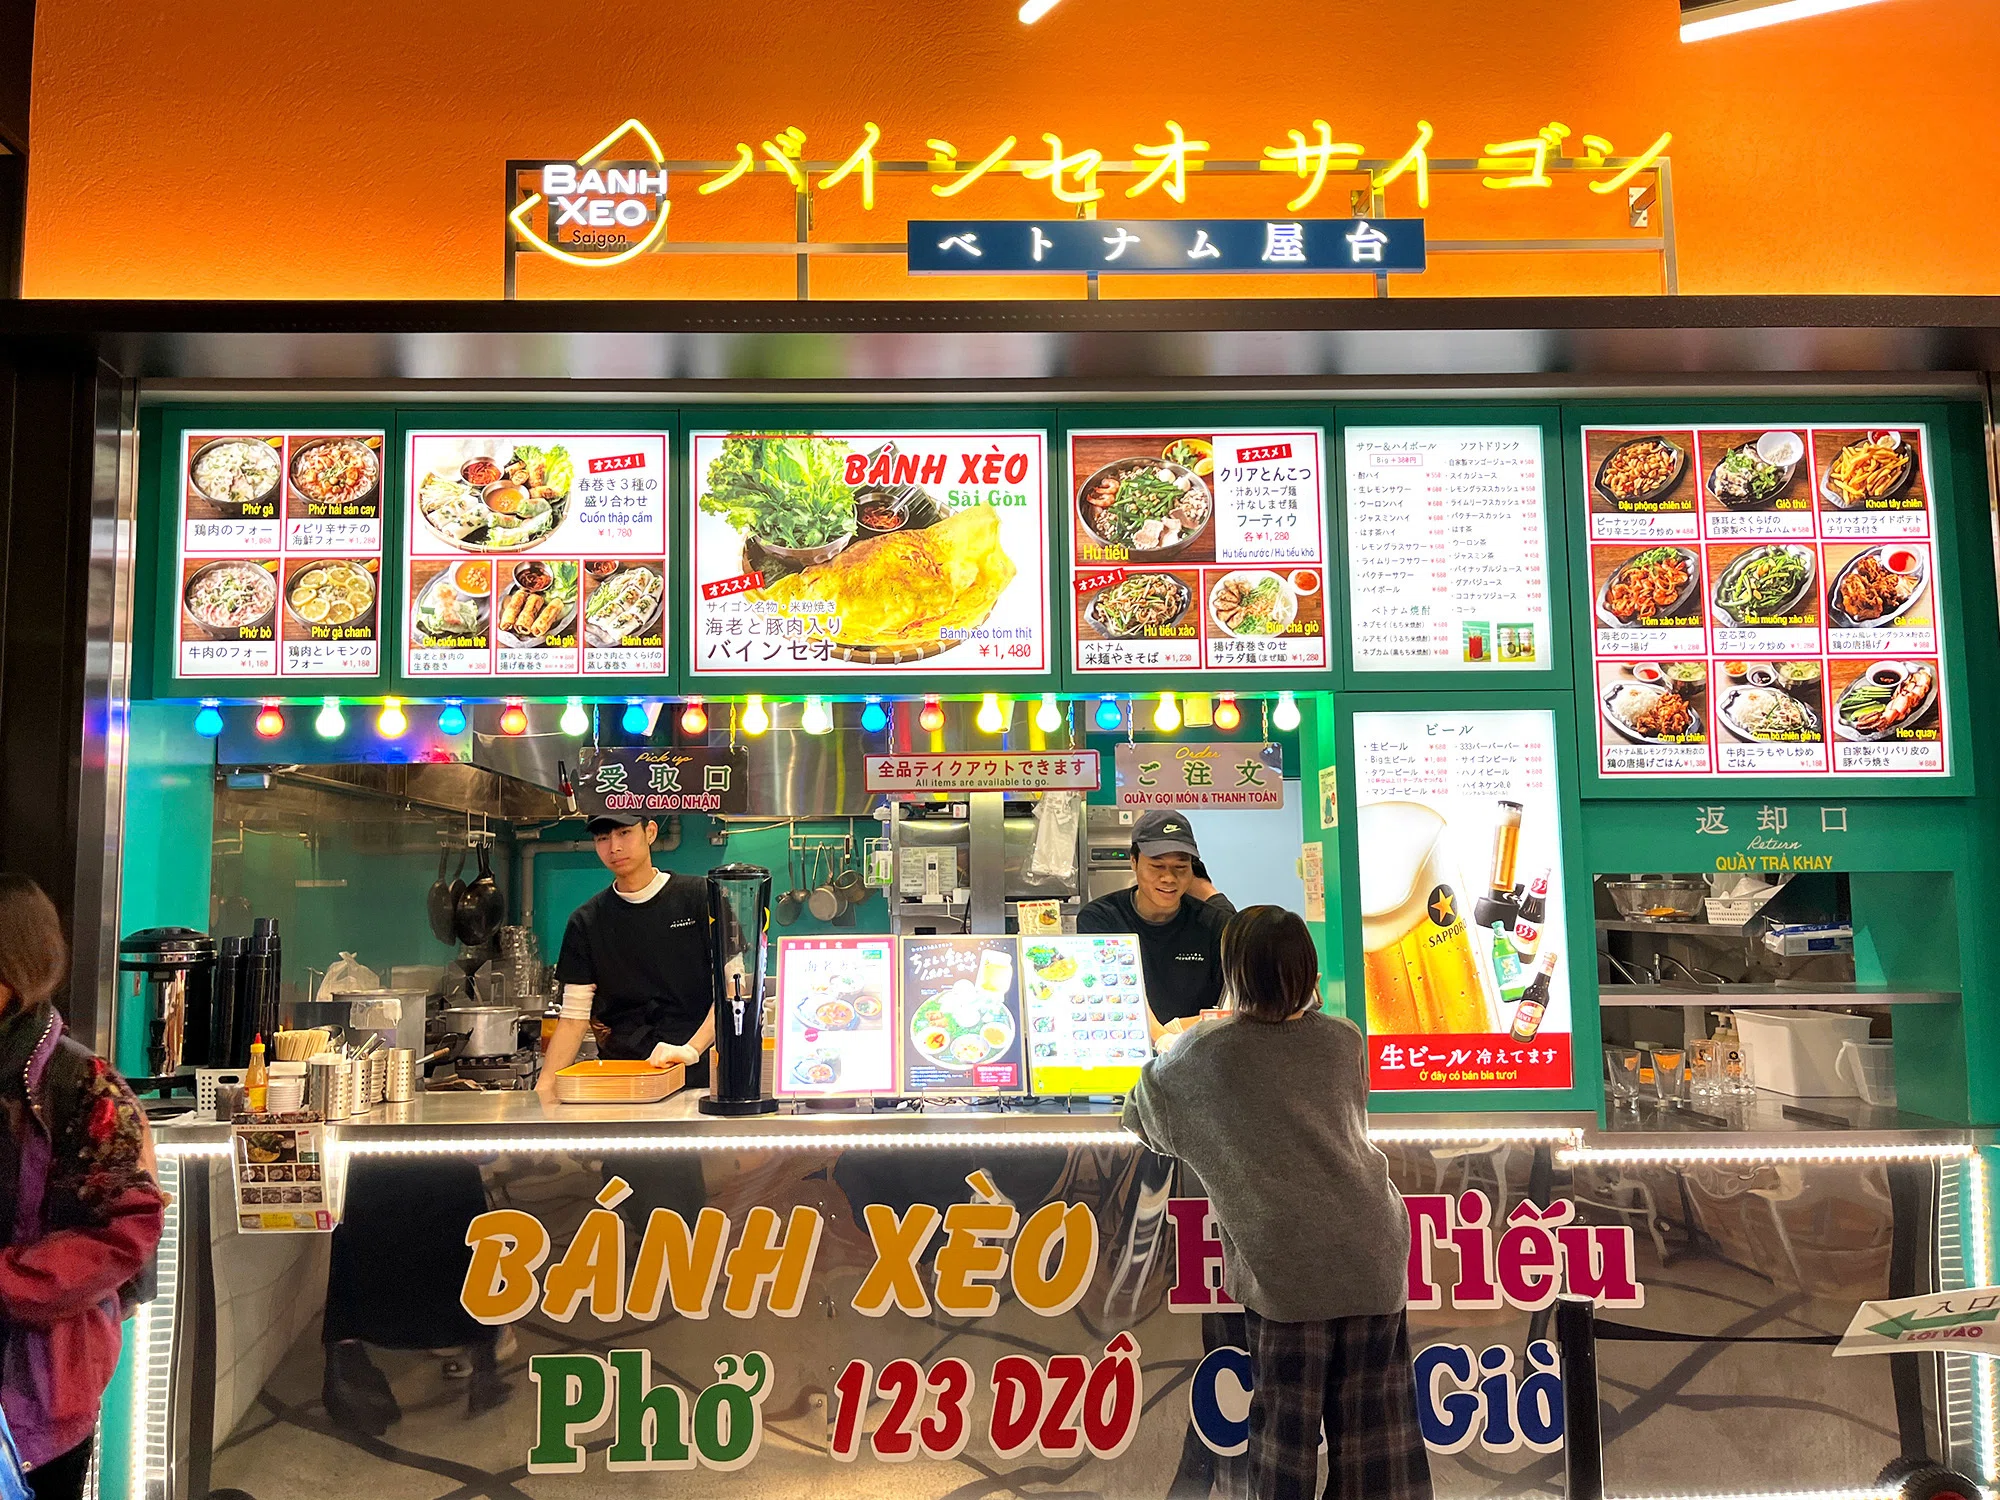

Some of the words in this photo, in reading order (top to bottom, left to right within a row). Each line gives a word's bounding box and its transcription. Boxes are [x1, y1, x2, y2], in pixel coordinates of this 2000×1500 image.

[542, 163, 668, 195] BANH
[555, 196, 648, 228] XEO
[572, 228, 627, 248] Saigon
[938, 221, 1389, 264] ベトナム屋台
[1460, 441, 1520, 451] ソフトドリンク
[845, 444, 947, 485] BÁNH
[958, 444, 1029, 485] XÈO
[1376, 456, 1389, 464] Big
[1220, 466, 1312, 483] クリアとんこつ
[584, 495, 648, 508] 盛り合わせ
[947, 490, 983, 507] Sài
[988, 490, 1028, 507] Gòn
[1359, 500, 1403, 508] ウーロンハイ
[1237, 513, 1297, 528] フーティウ
[1360, 514, 1410, 522] ジャスミンハイ
[1597, 517, 1647, 526] ピーナッツの
[194, 525, 273, 537] 鶏肉のフォー
[303, 523, 371, 534] ピリ辛サテの
[598, 528, 633, 538] ¥1,780
[1597, 527, 1674, 536] ピリ辛ニンニク炒め
[1828, 525, 1878, 534] チリマヨ付き
[292, 535, 346, 546] 海鮮フォー
[1362, 585, 1400, 594] ハイボール
[706, 600, 837, 614] サイゴン名物・米粉焼き
[1372, 605, 1431, 616] ベトナム焼酎
[345, 625, 371, 638] chanh
[705, 617, 842, 636] 海老と豚肉入り
[940, 627, 968, 639] Bánh
[970, 628, 988, 639] xèo
[991, 627, 1012, 639] tôm
[1014, 627, 1033, 641] thịt
[1601, 631, 1667, 640] 海老のニンニク
[289, 646, 371, 657] 鶏肉とレモンの
[707, 640, 836, 662] バインセオ
[979, 644, 1032, 659] ¥1,480
[1085, 643, 1123, 651] ベトナム
[1213, 641, 1288, 652] 揚げ春巻きのせ
[1602, 642, 1649, 651] バター揚げ
[1720, 641, 1786, 650] ガーリック炒め
[189, 646, 268, 659] 牛肉のフォー
[413, 652, 465, 660] 海老と豚肉の
[1085, 652, 1159, 665] 米麺やきそば
[1292, 653, 1319, 662] ¥1,280
[289, 659, 324, 669] フォー
[413, 662, 448, 671] 生春巻き
[500, 661, 542, 671] 揚げ春巻き
[587, 661, 628, 670] 蒸し春巻き
[1426, 723, 1474, 737] ビール
[1896, 728, 1914, 738] Heo
[1915, 729, 1937, 739] quay
[1176, 746, 1221, 760] Order
[1370, 742, 1408, 752] 生ビール
[1726, 748, 1814, 757] 牛肉ニラもやし炒め
[635, 751, 670, 763] Pick
[672, 756, 694, 766] up
[1370, 755, 1416, 765] Big生ビール
[1461, 755, 1517, 763] サイゴンビール
[1607, 758, 1684, 769] 鶏の唐揚げごはん
[878, 759, 1086, 778] 全品テイクアウトできます
[1138, 758, 1266, 788] ご注文
[1461, 768, 1510, 776] ハノイビール
[596, 763, 732, 793] 受取口
[915, 778, 928, 787] All
[931, 778, 957, 787] items
[959, 779, 974, 787] are
[977, 777, 1019, 787] available
[1022, 778, 1032, 787] to
[1034, 779, 1050, 788] go.
[1371, 787, 1428, 795] マンゴービール
[606, 791, 645, 809] QUẦY
[646, 794, 680, 809] GIAO
[682, 792, 721, 811] NHẬN
[1124, 790, 1153, 804] QUẦY
[1155, 793, 1173, 806] GỌI
[1176, 790, 1200, 803] MÓN
[1201, 793, 1209, 803] &
[1211, 792, 1246, 803] THANH
[1248, 790, 1277, 803] TOÁN
[1695, 804, 1848, 835] 返却口
[1746, 835, 1803, 851] Return
[1715, 852, 1757, 871] QUẦY
[1793, 855, 1833, 870] KHAY
[1428, 918, 1467, 948] SAPPORO
[1379, 1043, 1471, 1070] 生ビール
[1476, 1048, 1558, 1065] 冷えてます
[1430, 1070, 1448, 1083] đây
[1449, 1070, 1460, 1081] có
[1461, 1070, 1479, 1080] bán
[1480, 1070, 1494, 1080] bia
[461, 1175, 824, 1325] BÁNH
[852, 1168, 1099, 1317] XÈO
[1925, 1295, 1999, 1317] 入口
[830, 1358, 974, 1462] 123
[988, 1330, 1142, 1460] DZÔ
[527, 1348, 774, 1473] Phở
